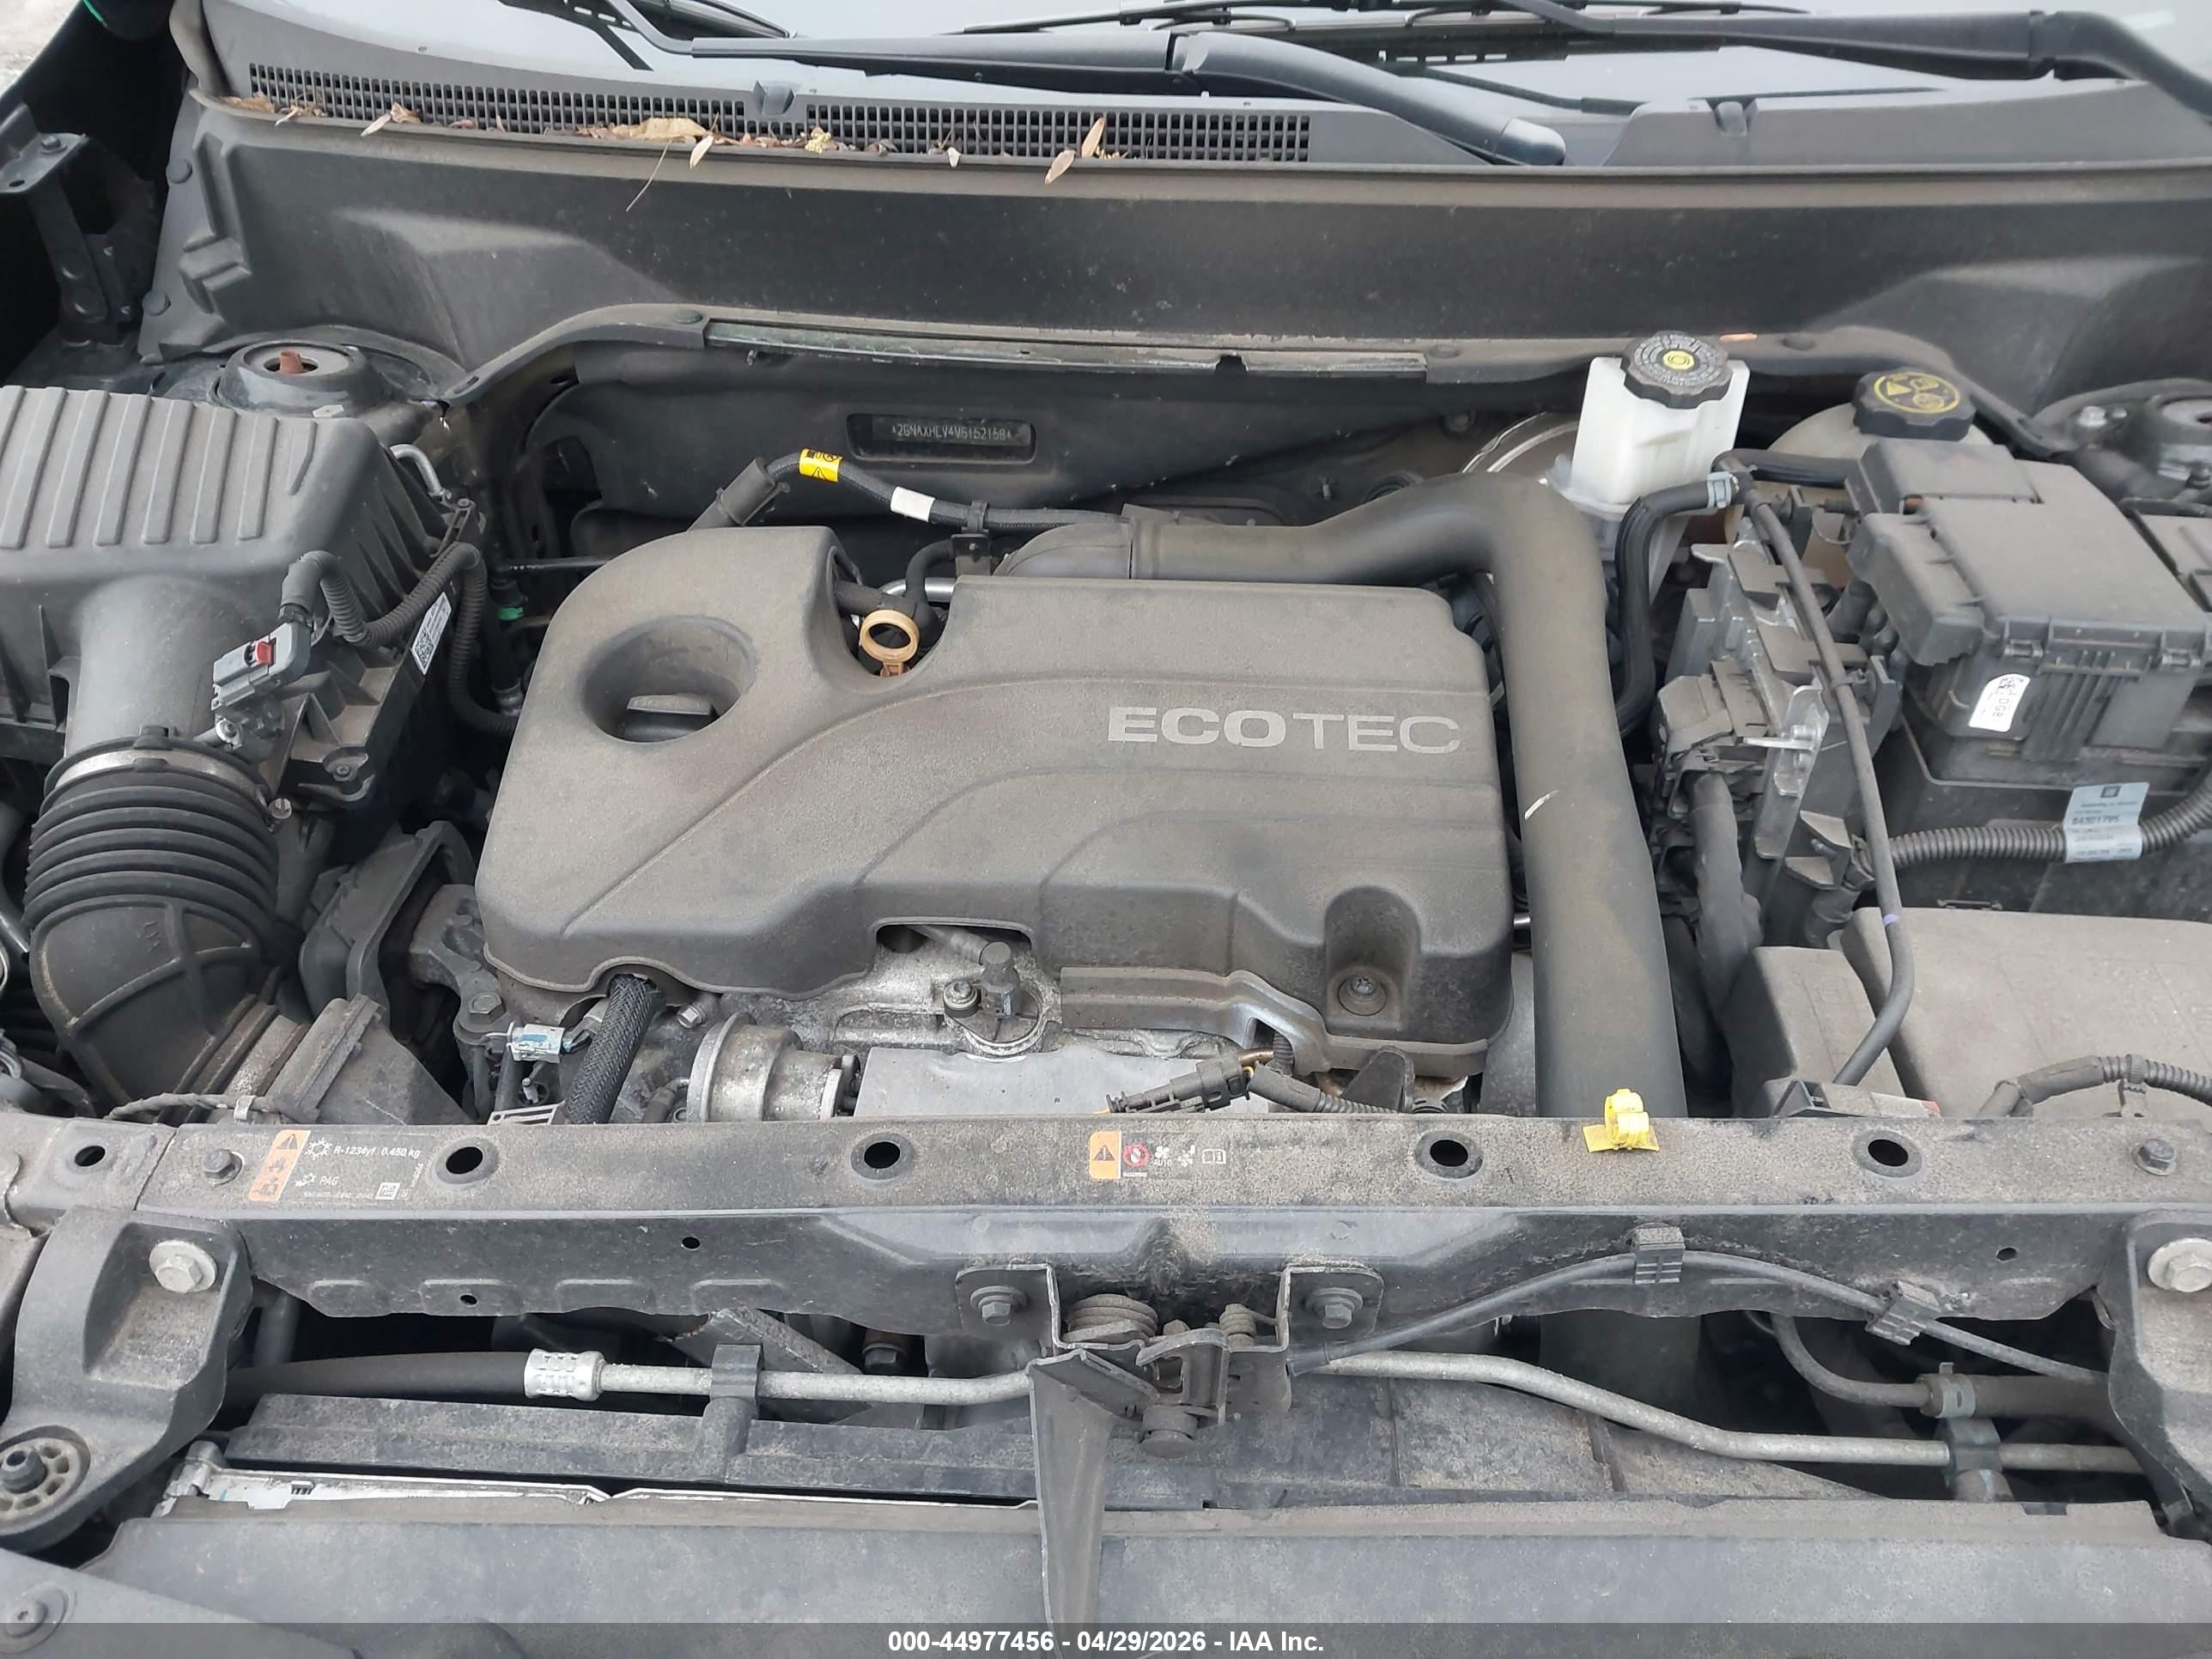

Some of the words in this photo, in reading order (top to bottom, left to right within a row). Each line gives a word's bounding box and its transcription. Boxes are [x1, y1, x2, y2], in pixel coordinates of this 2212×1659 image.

[1108, 707, 1461, 754] ECOTEC
[408, 1148, 422, 1159] kg
[319, 1176, 340, 1186] PAG
